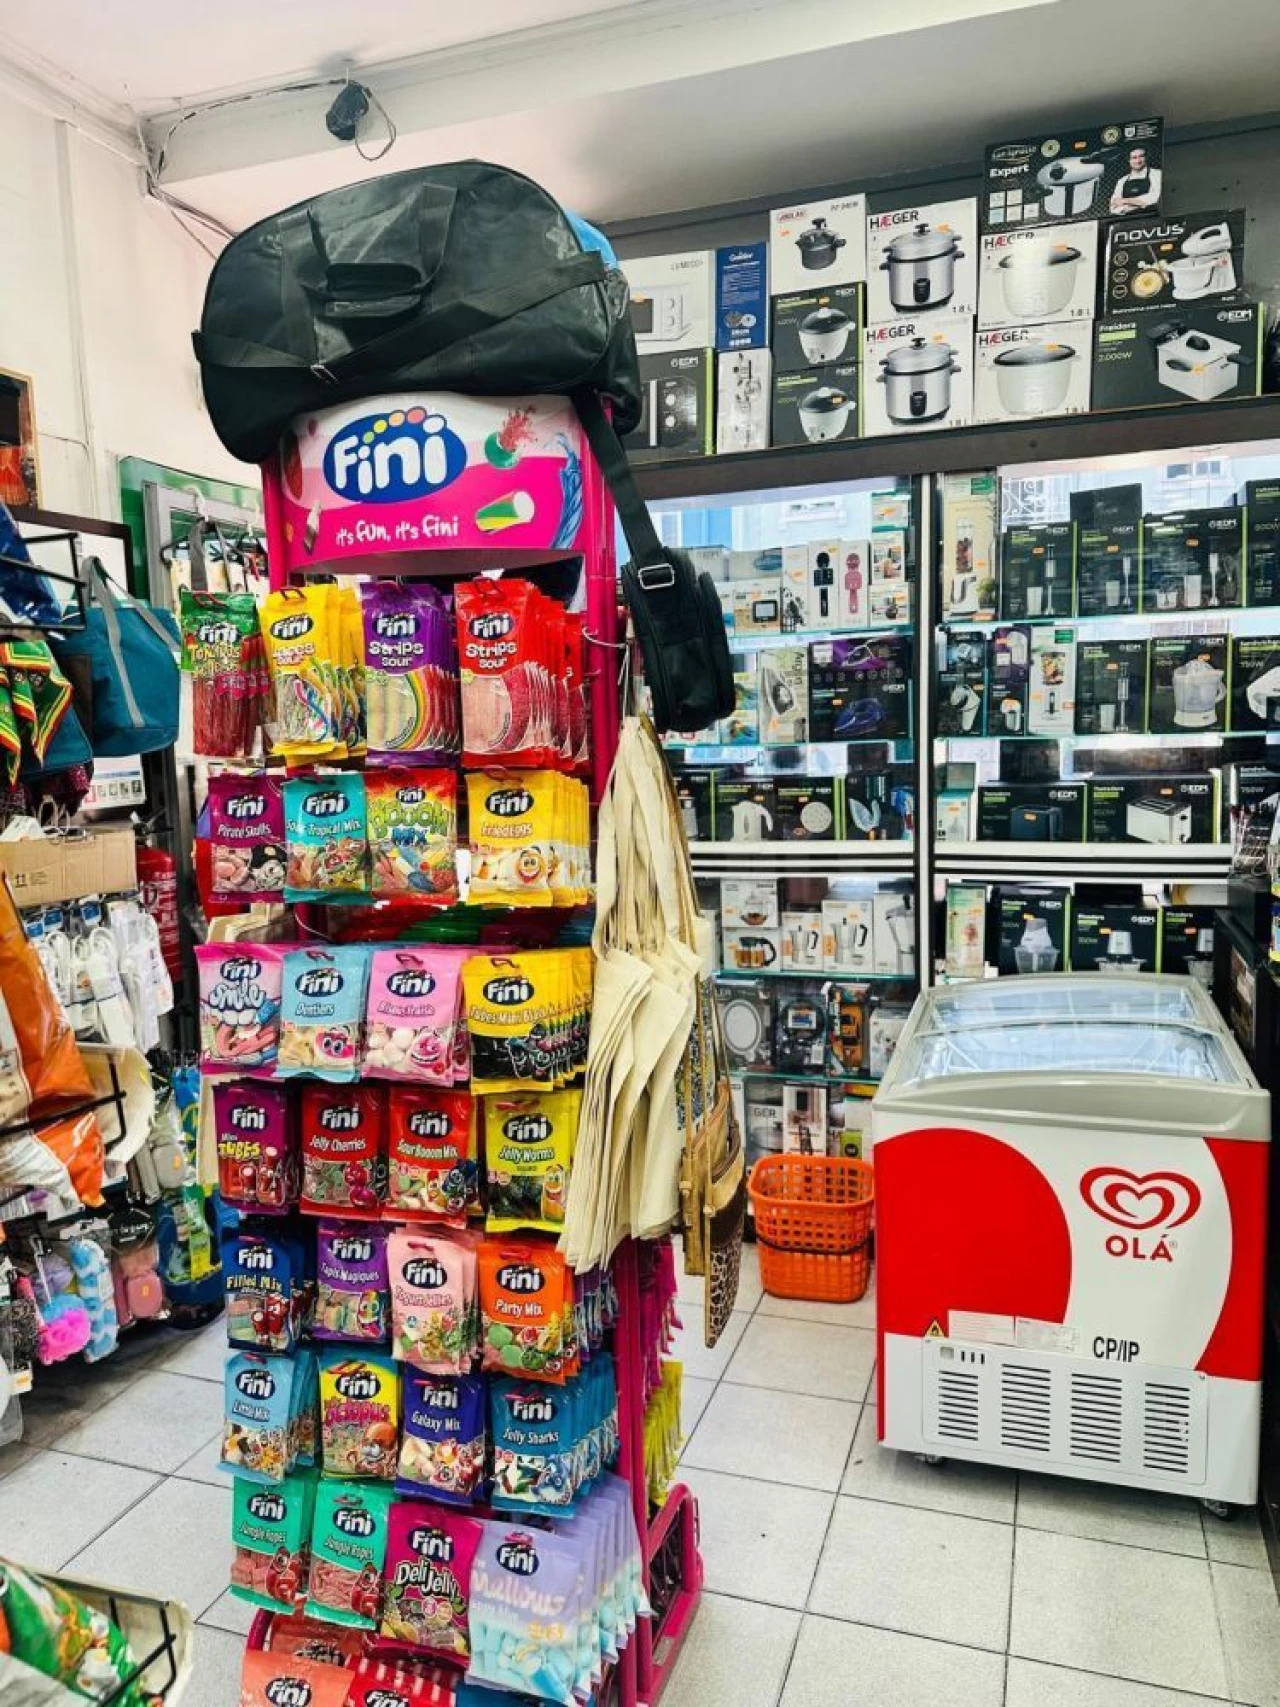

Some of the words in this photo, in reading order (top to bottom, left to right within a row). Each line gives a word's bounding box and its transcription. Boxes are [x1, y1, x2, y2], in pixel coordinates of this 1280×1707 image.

[989, 164, 1029, 179] Expert
[1228, 309, 1252, 320] EDM
[333, 414, 448, 494] Fini
[336, 528, 354, 546] it's
[396, 521, 419, 541] it's
[422, 514, 459, 538] fini
[200, 622, 238, 643] Fini
[273, 615, 309, 638] Fini
[377, 613, 416, 637] Fini
[473, 612, 510, 638] Fini
[369, 641, 424, 656] Strips
[466, 642, 517, 657] Strips
[227, 795, 264, 817] Fini
[306, 793, 346, 815] Fini
[398, 788, 423, 802] Fini
[490, 791, 529, 814] Fini
[217, 824, 246, 838] Pirate
[308, 820, 341, 838] Tropical
[344, 818, 362, 832] Mix
[223, 959, 257, 979] Fini
[299, 970, 339, 994] Fini
[390, 973, 432, 995] Fini
[488, 978, 529, 1002] Fini
[232, 1107, 266, 1130] Fini
[321, 1104, 361, 1130] Fini
[411, 1113, 447, 1135] Fini
[508, 1114, 546, 1140] Fini
[310, 1135, 329, 1151] Jelly
[331, 1137, 366, 1152] Cherries
[499, 1147, 521, 1163] Jelly
[521, 1147, 555, 1161] Worms
[238, 1247, 274, 1269] Fini
[333, 1237, 372, 1260] Fini
[1105, 1234, 1173, 1262] OLÁ
[226, 1274, 258, 1289] Filled
[260, 1276, 282, 1292] Mix
[406, 1261, 443, 1286] Fini
[501, 1267, 541, 1290] Fini
[495, 1298, 521, 1317] Party
[524, 1301, 543, 1316] Mix
[1093, 1336, 1140, 1362] CP/IP
[238, 1373, 273, 1398] Fini
[340, 1373, 378, 1397] Fini
[423, 1384, 459, 1409] Fini
[513, 1397, 552, 1421] Fini
[411, 1410, 442, 1432] Galaxy
[445, 1417, 461, 1431] Mix
[503, 1427, 525, 1444] Jelly
[528, 1430, 559, 1445] Sharks
[250, 1496, 284, 1520] Fini
[336, 1510, 373, 1536] Fini
[412, 1529, 453, 1561] Fini
[500, 1546, 535, 1574] Fini
[268, 1682, 309, 1707] Fini
